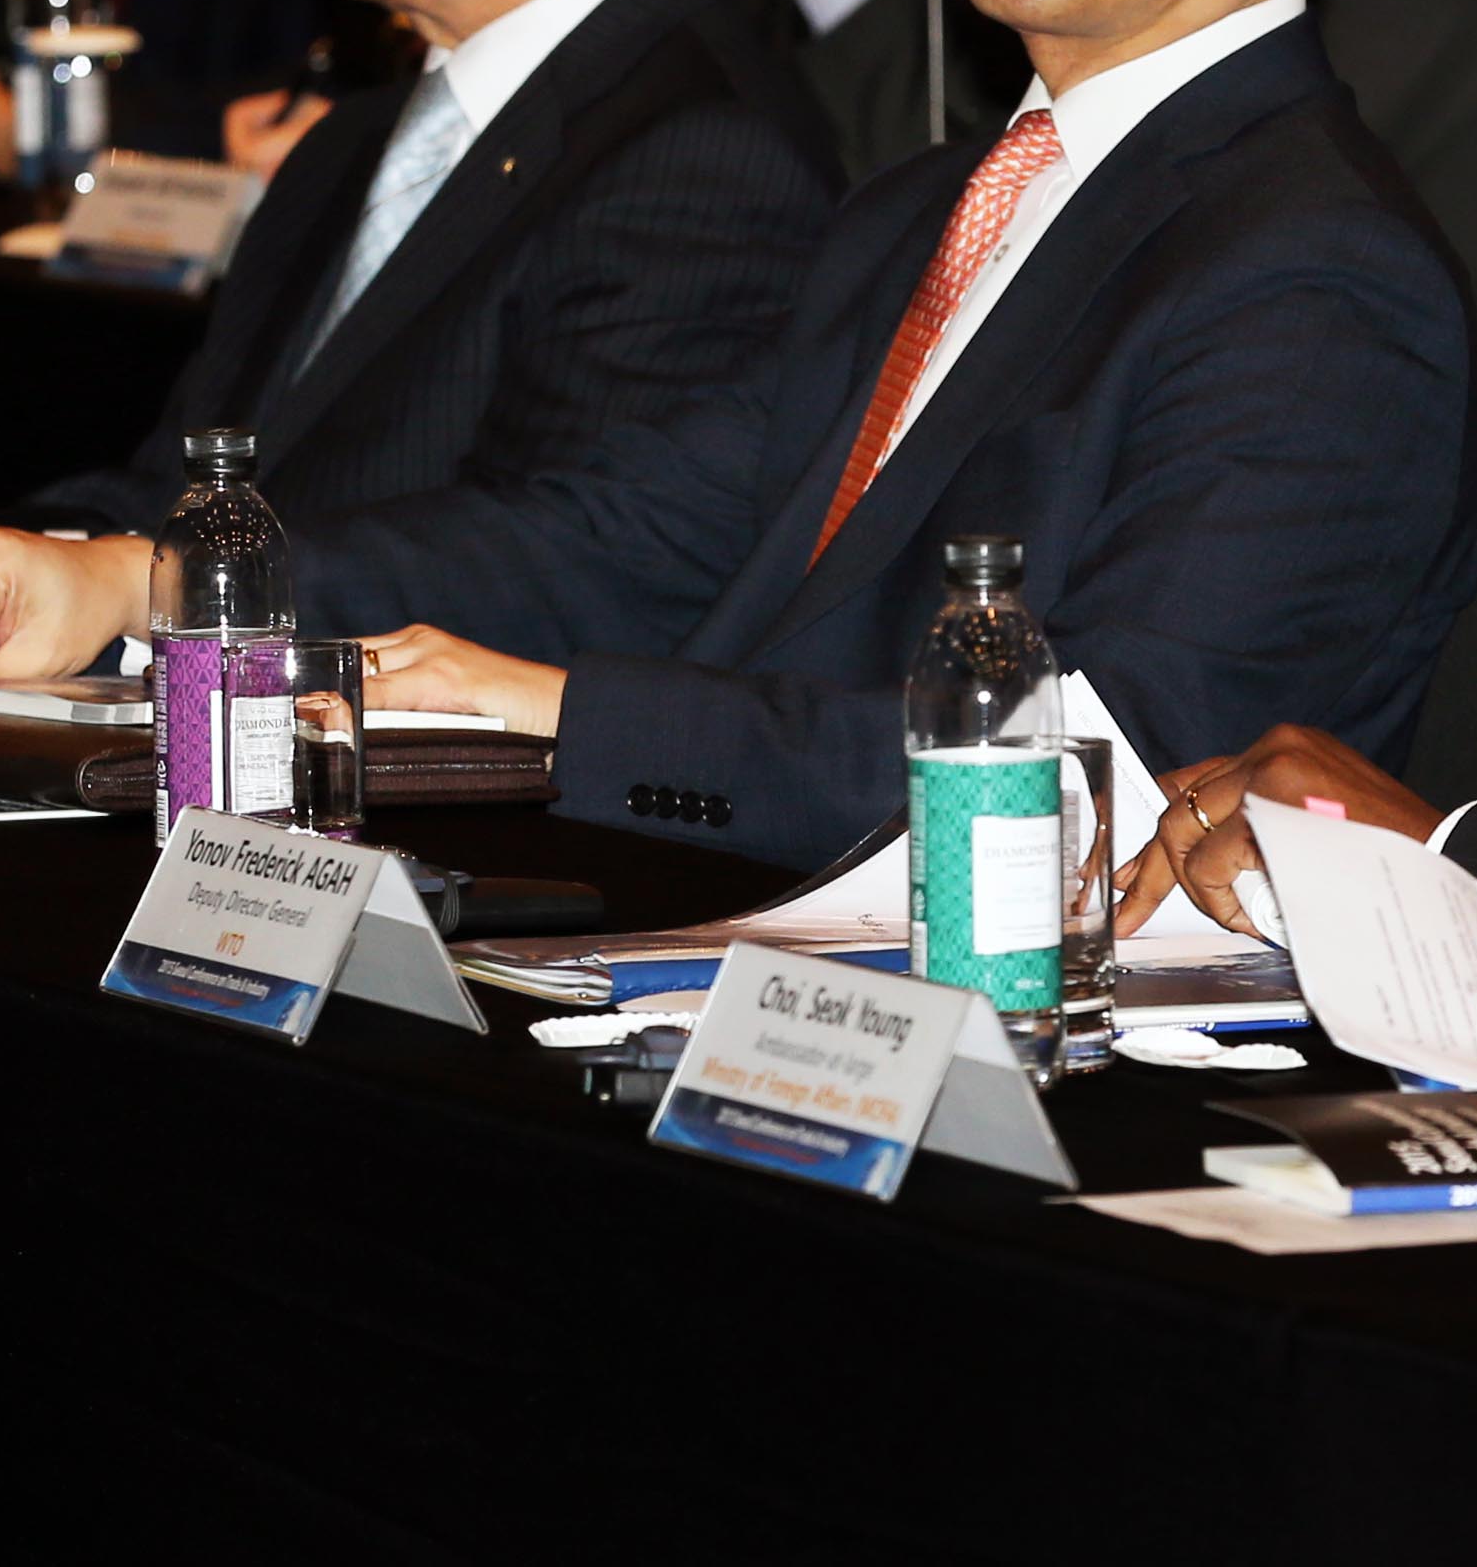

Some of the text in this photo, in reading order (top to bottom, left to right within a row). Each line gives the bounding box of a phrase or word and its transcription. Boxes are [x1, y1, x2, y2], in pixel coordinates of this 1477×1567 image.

[183, 828, 360, 897] Yonov Frederick AGAH
[187, 881, 314, 928] Deputy Director General
[214, 930, 246, 957] WTO
[757, 974, 916, 1053] Choi, Seok Young
